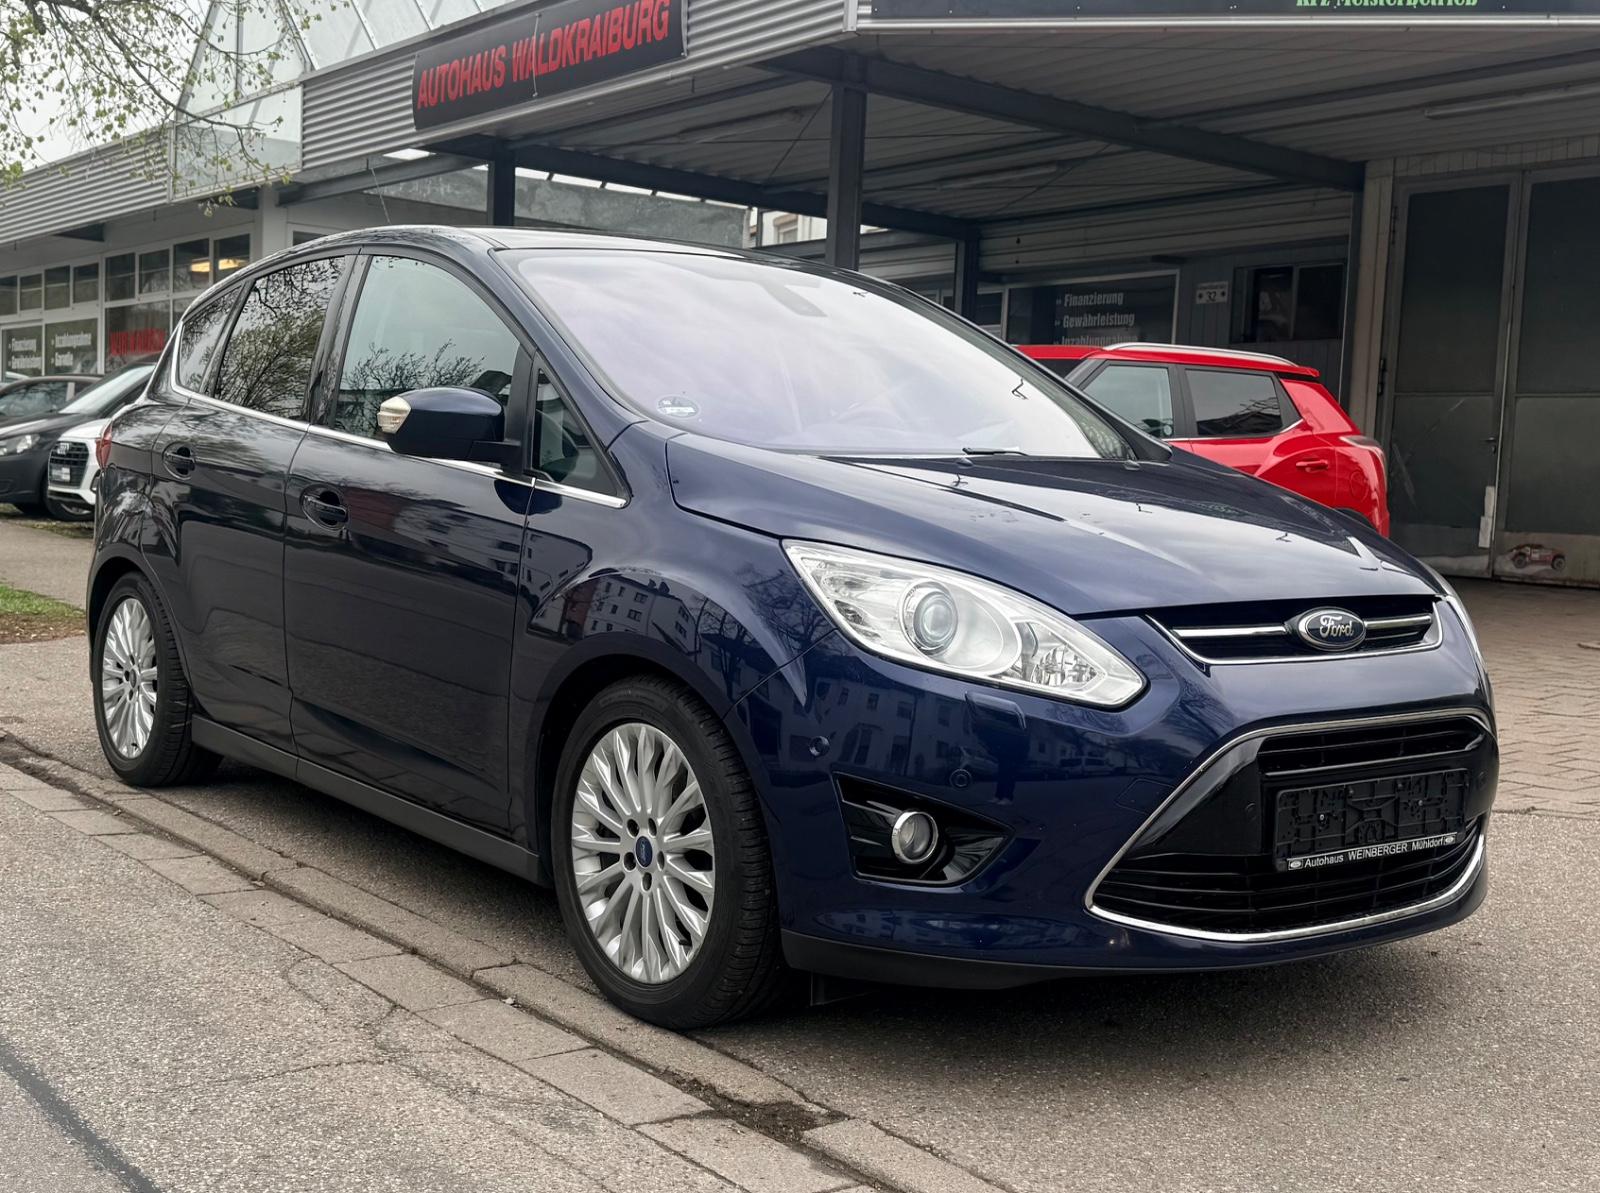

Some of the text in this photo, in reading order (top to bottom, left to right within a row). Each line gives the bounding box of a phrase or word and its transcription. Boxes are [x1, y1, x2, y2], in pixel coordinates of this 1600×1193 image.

[417, 0, 670, 109] AUTOHAUS WALDKRAIBURG
[1064, 291, 1124, 307] Finanzierung
[1063, 312, 1135, 329] Gewährleistung
[1319, 614, 1355, 638] Ford
[1304, 854, 1344, 869] Autohaus
[1348, 843, 1407, 861] WEINBERGER
[1411, 836, 1444, 851] Mühldorf
